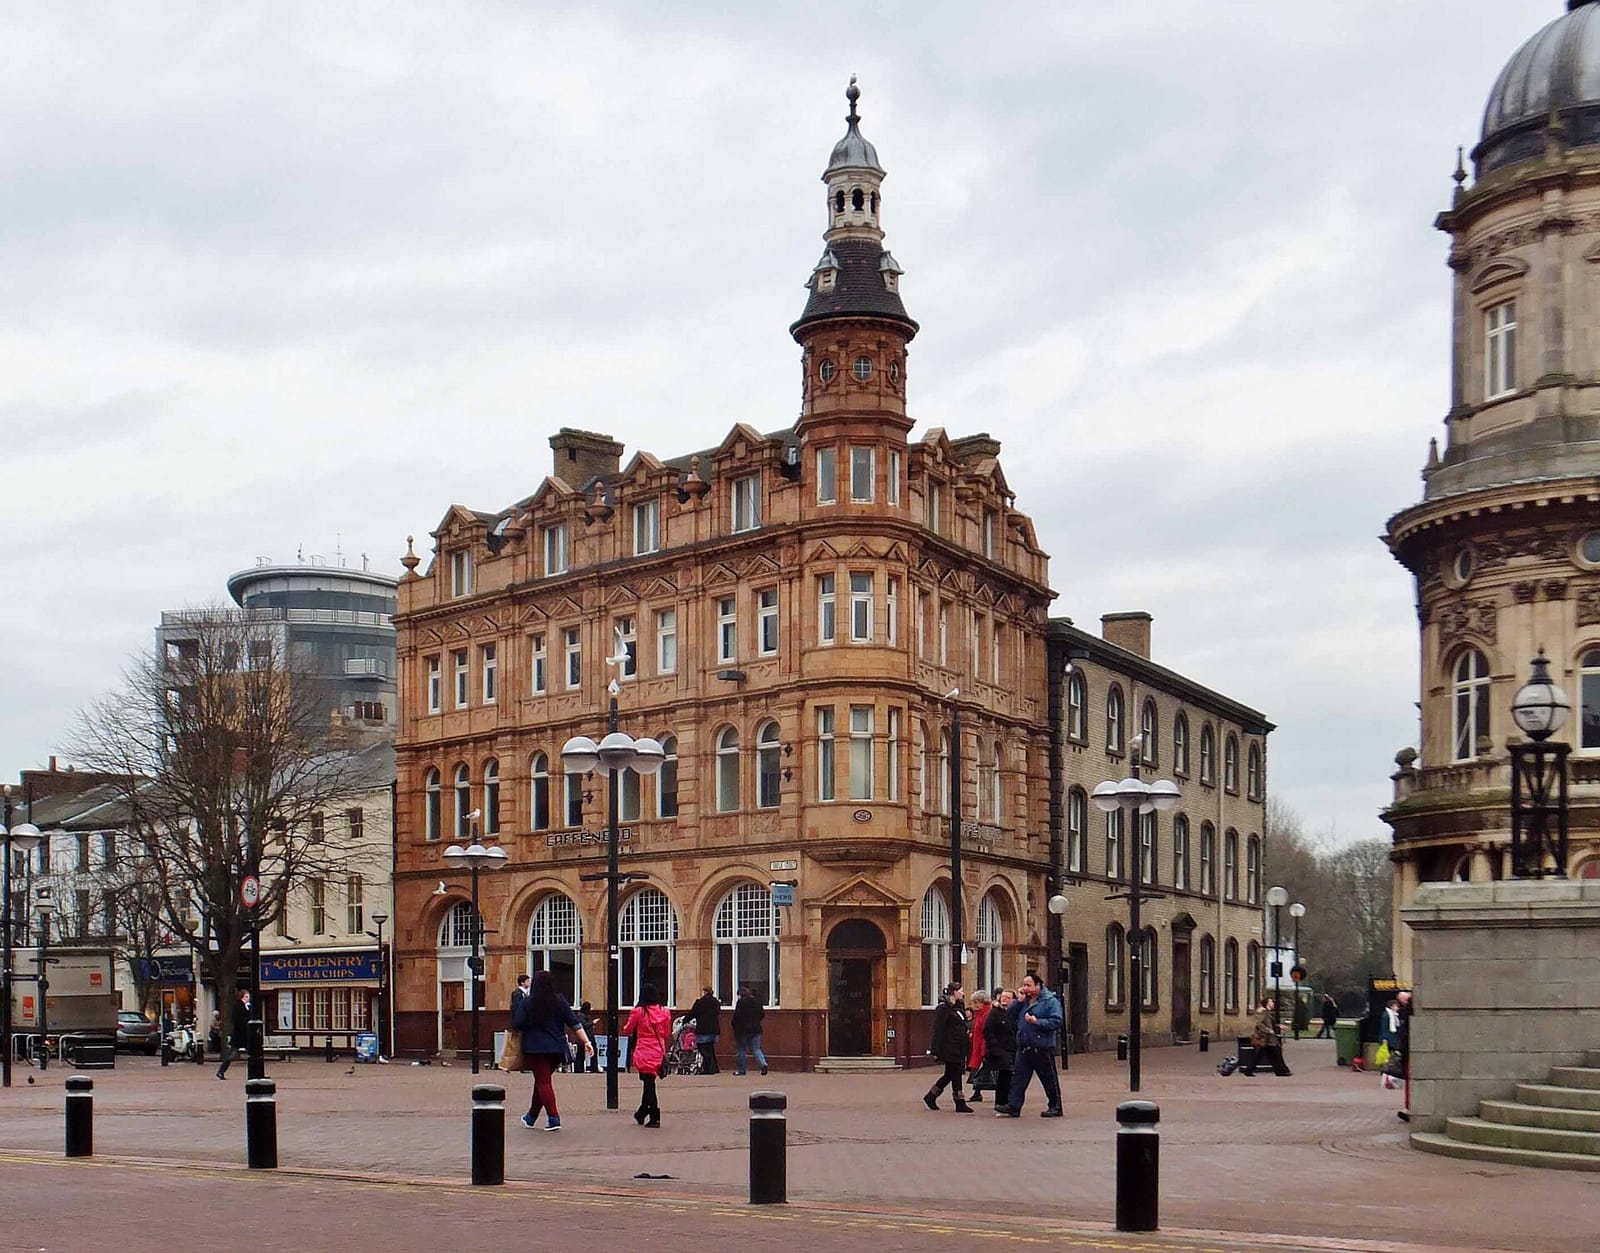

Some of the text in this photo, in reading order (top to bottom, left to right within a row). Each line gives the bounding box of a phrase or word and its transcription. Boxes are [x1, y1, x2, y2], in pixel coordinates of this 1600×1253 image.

[591, 828, 631, 842] NEO
[273, 956, 364, 969] GOLDENFRY
[288, 969, 355, 979] FISH & CHIPS
